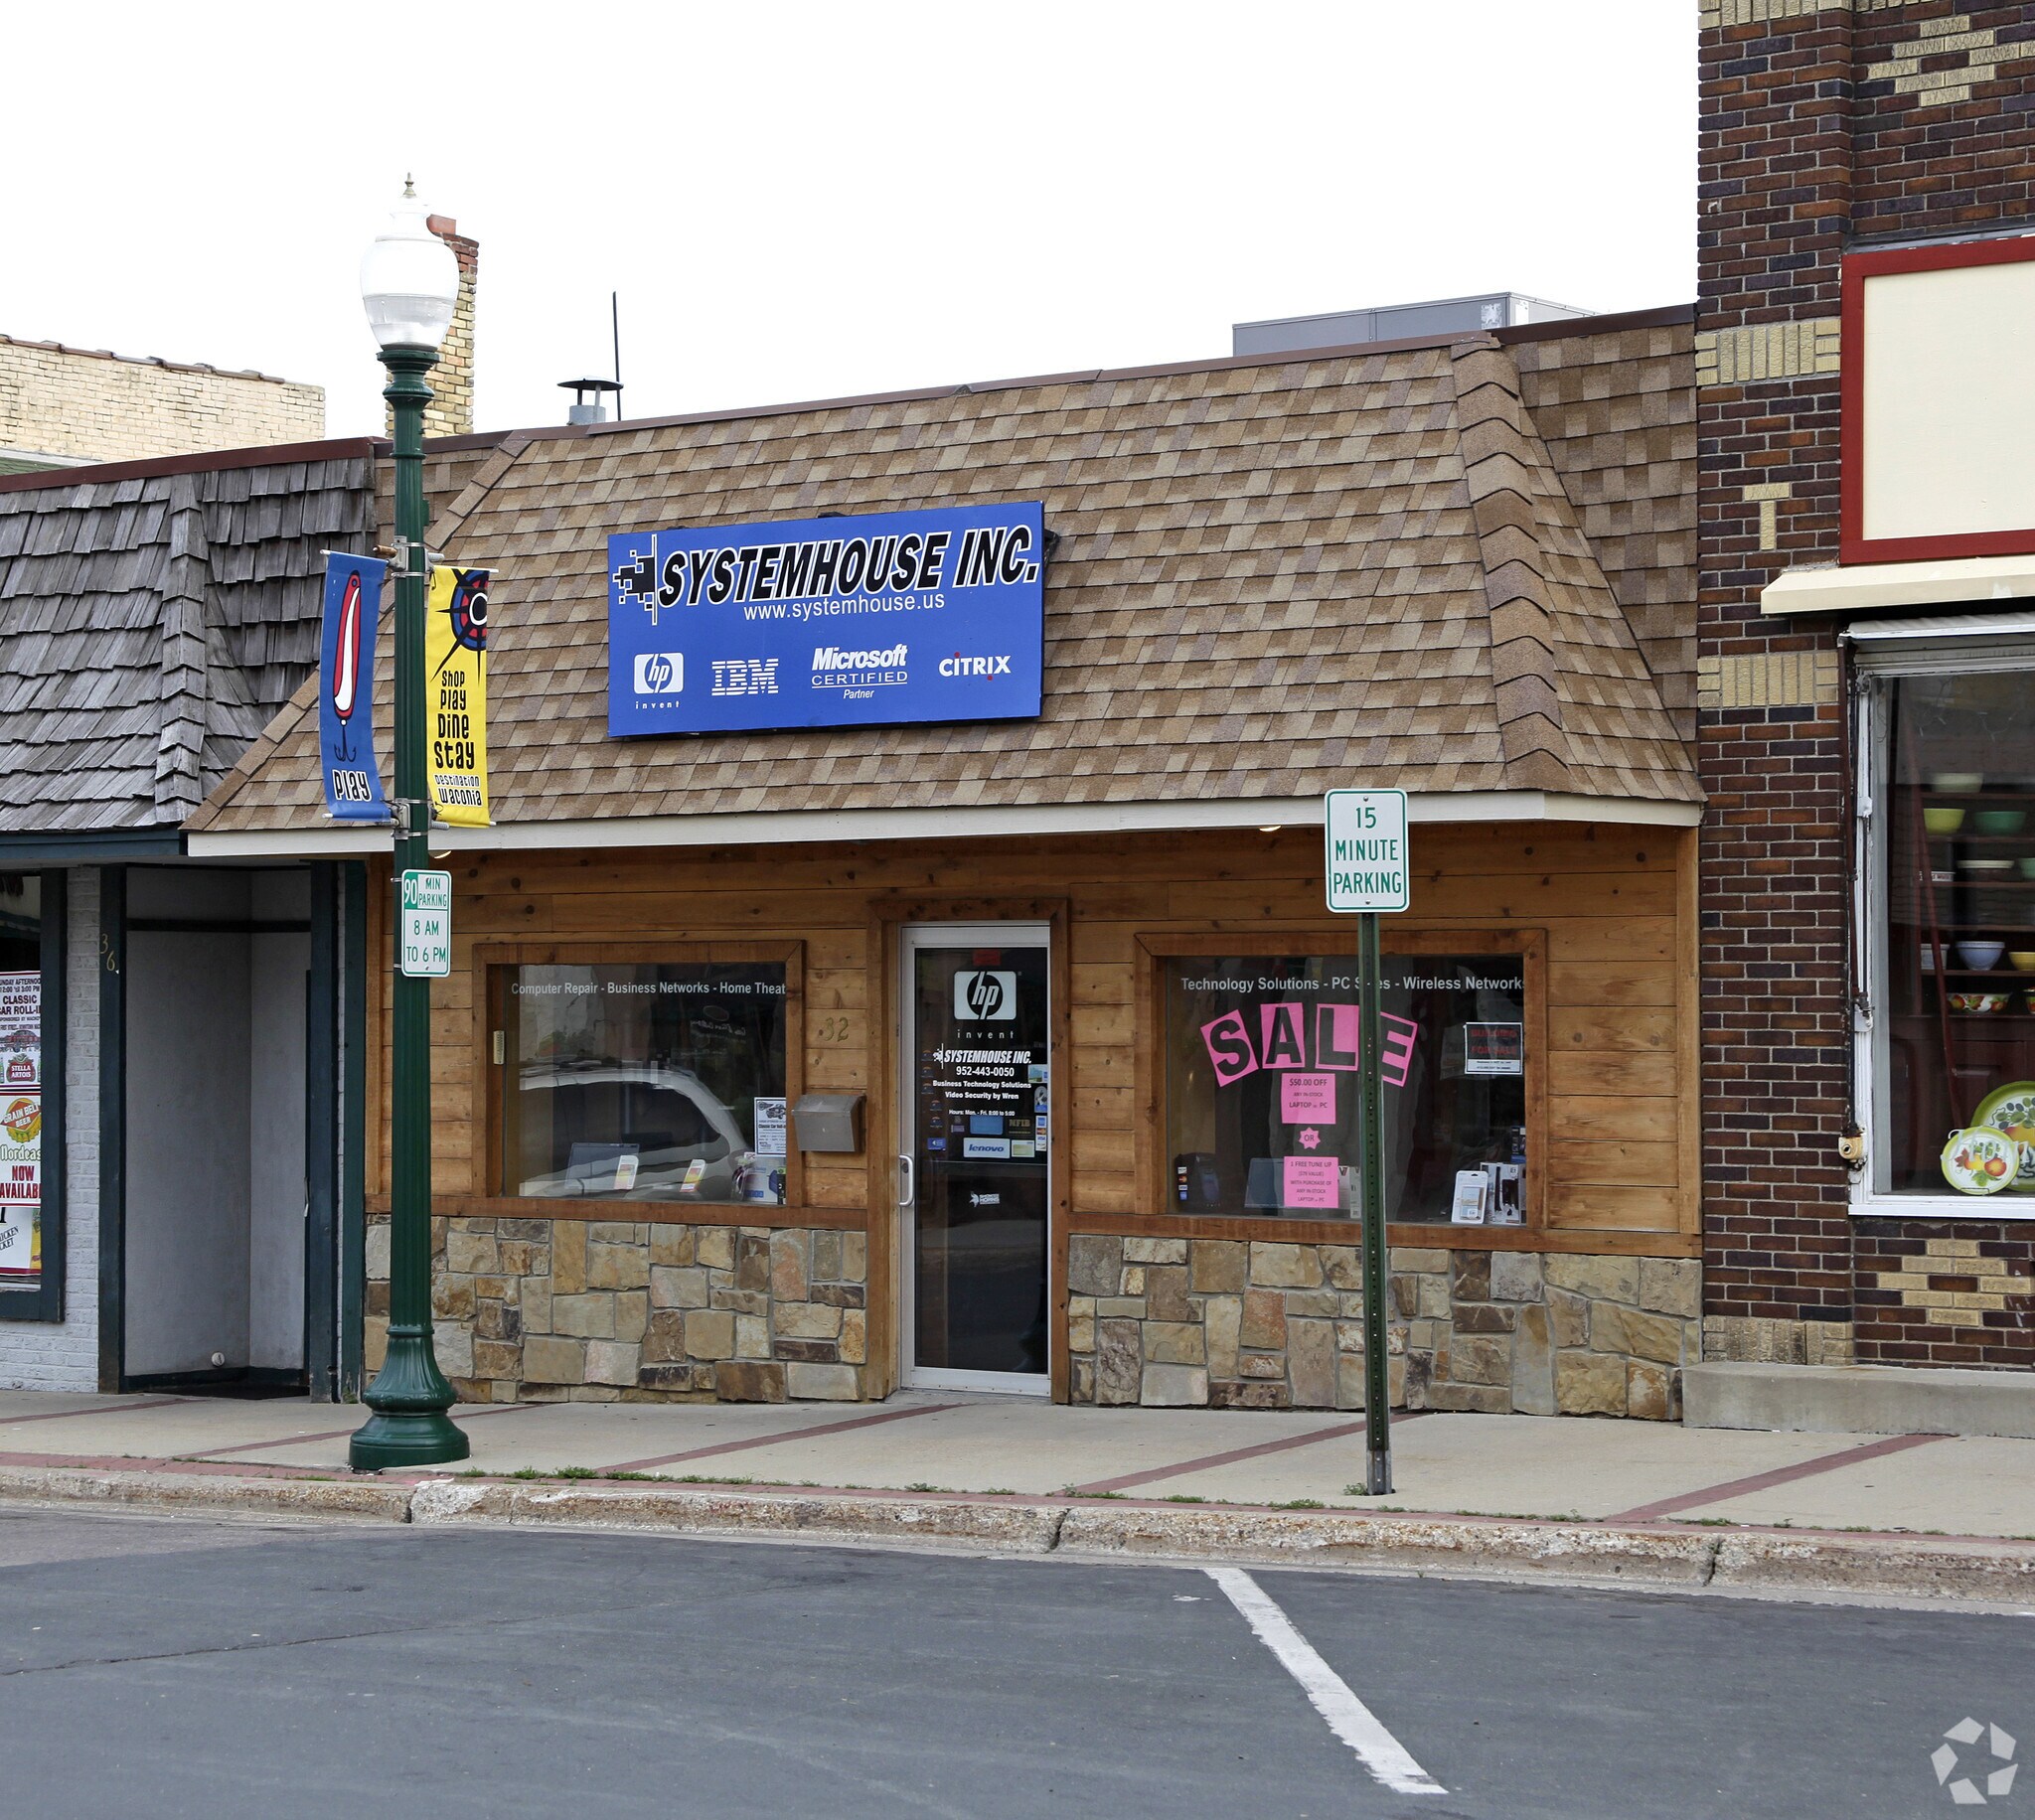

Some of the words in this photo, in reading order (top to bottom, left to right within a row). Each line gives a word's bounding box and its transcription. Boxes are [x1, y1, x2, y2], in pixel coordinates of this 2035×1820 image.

[657, 531, 952, 608] SYSTEMHOUSE
[952, 524, 1040, 588] INC.
[744, 593, 945, 622] www.systemhouse.us
[812, 644, 908, 671] Microsoft
[939, 653, 1012, 681] CITRIX
[711, 659, 779, 696] IBM
[811, 671, 908, 685] CERTIFIED
[843, 688, 875, 699] Partner
[437, 713, 469, 739] Dine
[434, 741, 474, 769] Stay
[1356, 808, 1376, 829] 15
[1335, 839, 1398, 861] MINUTE
[425, 878, 440, 890] MIN
[1333, 871, 1401, 893] PARKING
[404, 879, 417, 905] 90
[418, 893, 447, 906] PARKING
[413, 920, 420, 935] 8
[425, 920, 439, 936] AM
[406, 947, 418, 962] TO
[422, 947, 429, 962] 6
[433, 947, 446, 963] PM
[511, 983, 561, 996] Computer
[564, 983, 598, 996] Repair
[607, 982, 656, 993] Business
[660, 982, 709, 993] Networks
[719, 982, 751, 993] Home
[1181, 978, 1254, 993] Technology
[1258, 977, 1320, 990] Solutions
[1331, 977, 1350, 990] PC
[1403, 977, 1461, 990] Wireless
[2, 995, 37, 1004] CLASSIC
[826, 1017, 849, 1042] 32
[957, 1029, 1014, 1039] invent
[1210, 1005, 1415, 1082] SALE
[944, 1050, 1013, 1063] SYSTEMHOUSE
[1013, 1051, 1032, 1064] INC.
[956, 1066, 1015, 1077] 952-443-0050
[963, 1080, 1000, 1089] Technology
[1289, 1078, 1312, 1086] $50.00
[964, 1092, 992, 1100] Security
[23, 1103, 40, 1116] BELT
[15, 1116, 32, 1127] BEER
[968, 1144, 1005, 1152] lenovo
[12, 1165, 34, 1181] NOW
